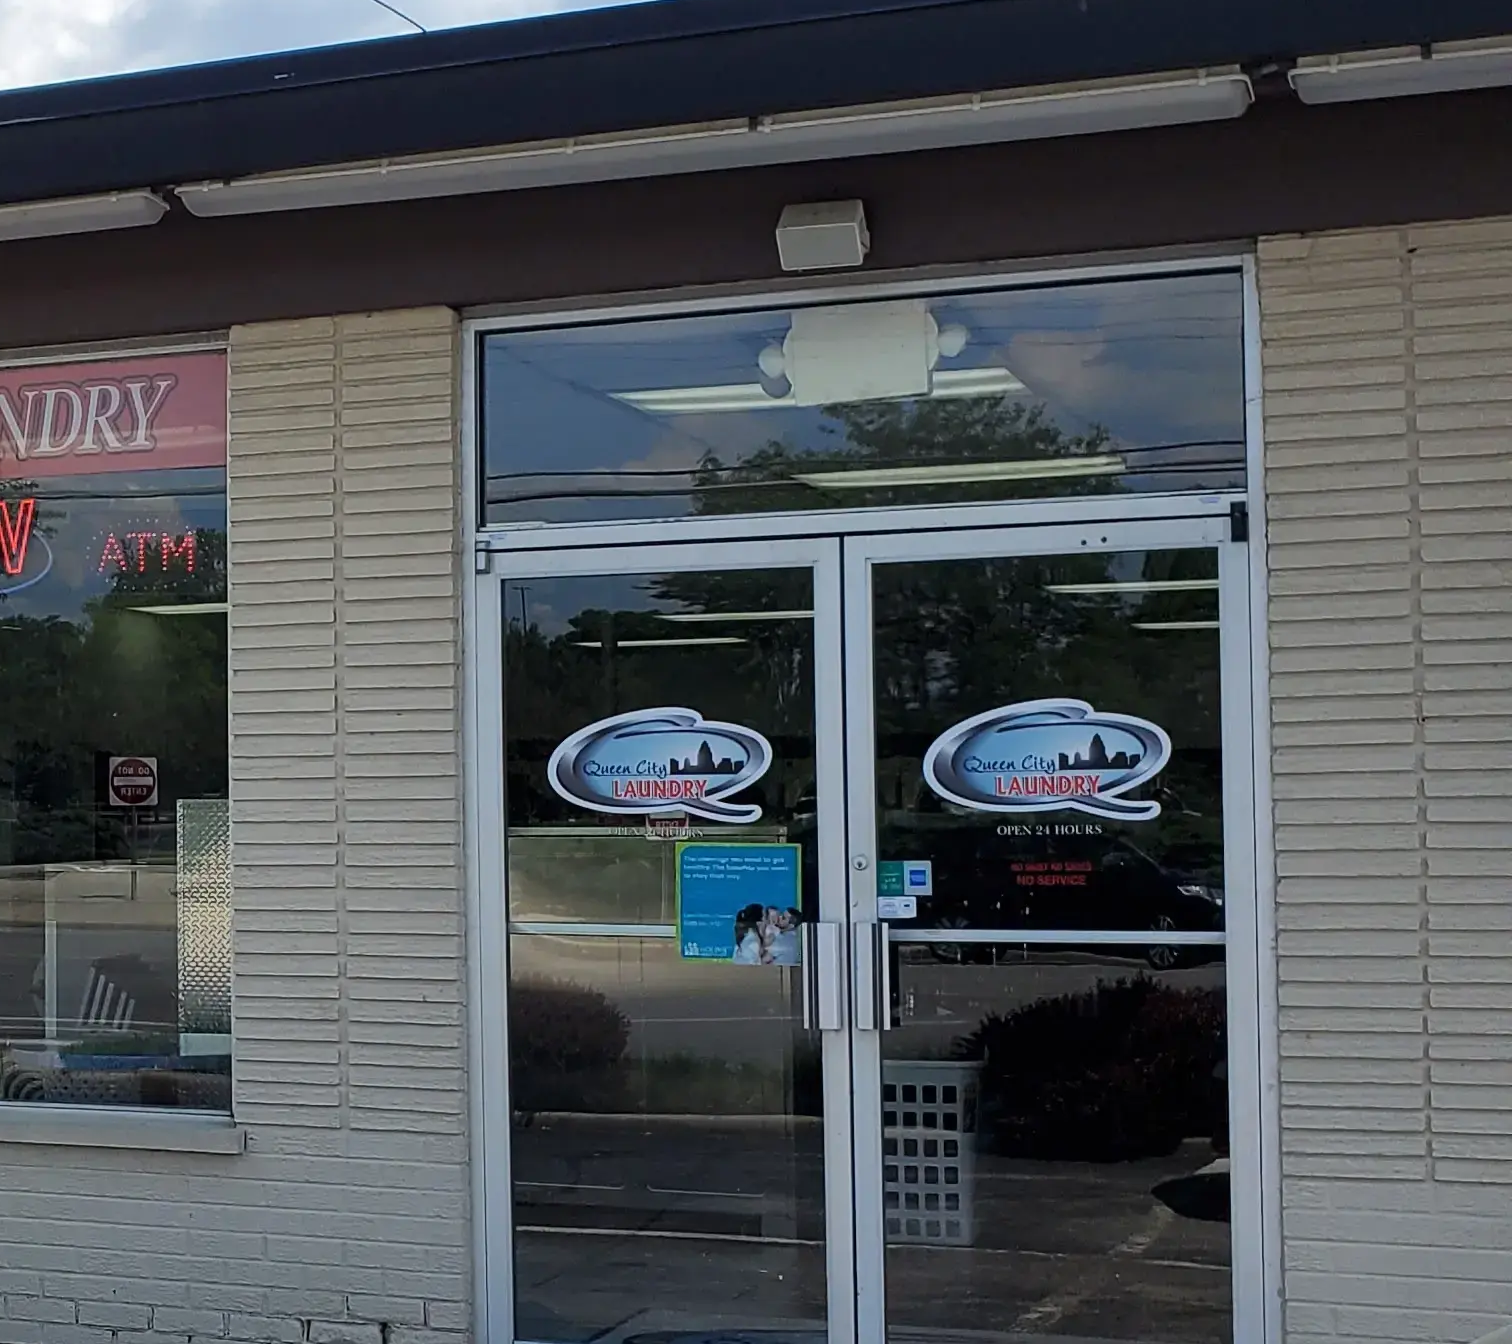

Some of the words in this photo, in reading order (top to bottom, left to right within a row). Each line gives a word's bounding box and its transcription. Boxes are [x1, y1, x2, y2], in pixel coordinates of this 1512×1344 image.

[97, 530, 197, 573] ATM
[583, 759, 631, 777] Queen
[635, 759, 668, 779] City
[963, 756, 1016, 773] Queen
[1021, 754, 1056, 774] City
[612, 779, 708, 800] LAUNDRY
[995, 775, 1101, 797] LAUNDRY
[996, 824, 1032, 836] OPEN
[1035, 824, 1050, 836] 24
[1054, 824, 1103, 835] HOURS
[1037, 874, 1087, 886] SERVICE
